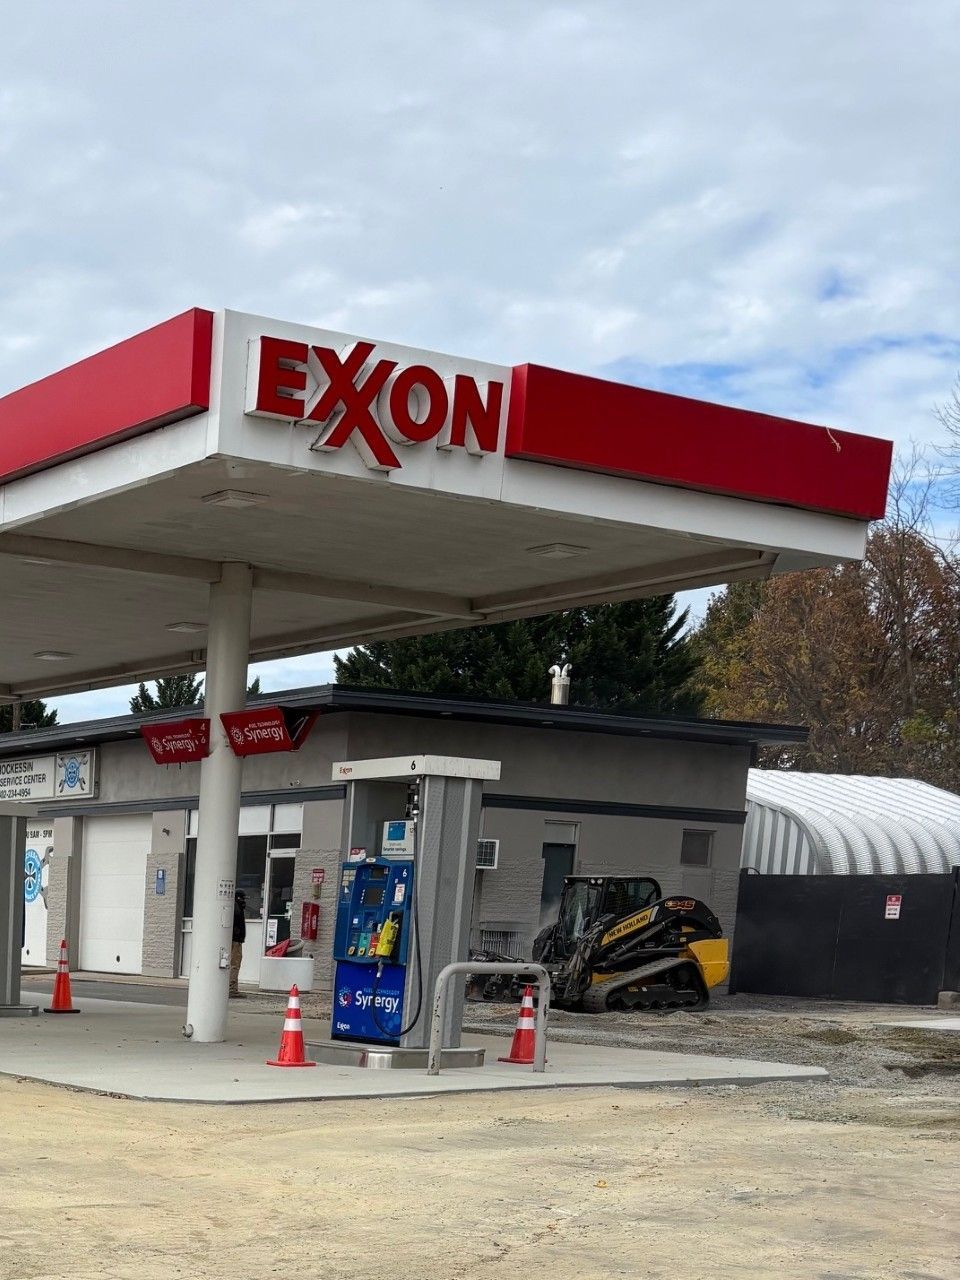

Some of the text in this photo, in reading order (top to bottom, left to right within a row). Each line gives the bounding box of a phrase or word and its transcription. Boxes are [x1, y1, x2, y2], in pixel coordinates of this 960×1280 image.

[247, 335, 504, 471] EXXON
[244, 726, 284, 744] Synergy
[162, 738, 196, 754] Synergy
[410, 760, 416, 770] 6
[0, 776, 23, 788] SERVICE
[23, 773, 47, 785] CENTER
[402, 868, 408, 878] 6
[608, 914, 649, 938] NEW HOLLAND
